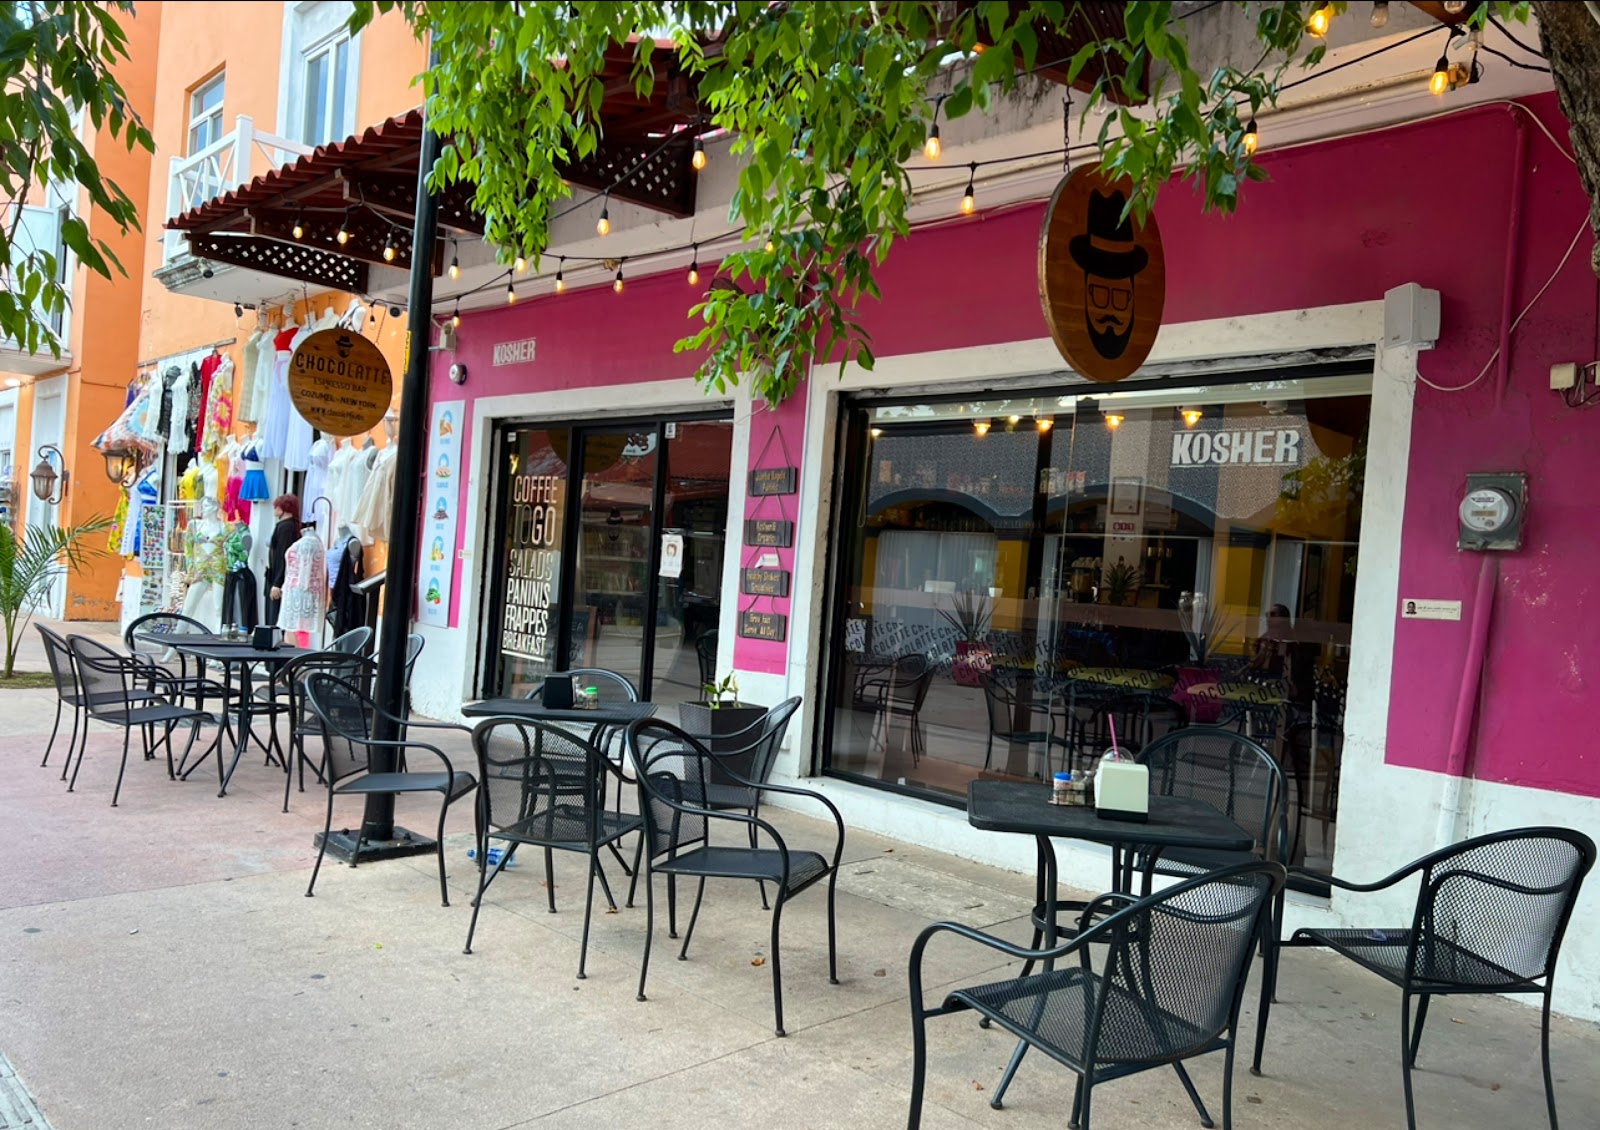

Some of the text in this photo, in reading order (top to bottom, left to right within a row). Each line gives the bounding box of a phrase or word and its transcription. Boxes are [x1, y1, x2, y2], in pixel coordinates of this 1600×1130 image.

[493, 339, 536, 366] KOSHER
[296, 352, 391, 385] CHOCOLATTE
[300, 389, 335, 402] COZUMEL
[340, 396, 357, 406] NEW
[358, 399, 377, 409] YORK
[313, 377, 367, 393] ESPRESSO BAR
[1171, 429, 1300, 465] KOSHER
[513, 475, 559, 504] COFFEE
[508, 548, 553, 582] SALADS
[506, 577, 551, 609] PANINIS
[504, 603, 549, 636] FRAPPES
[502, 630, 547, 656] BREAKFAST
